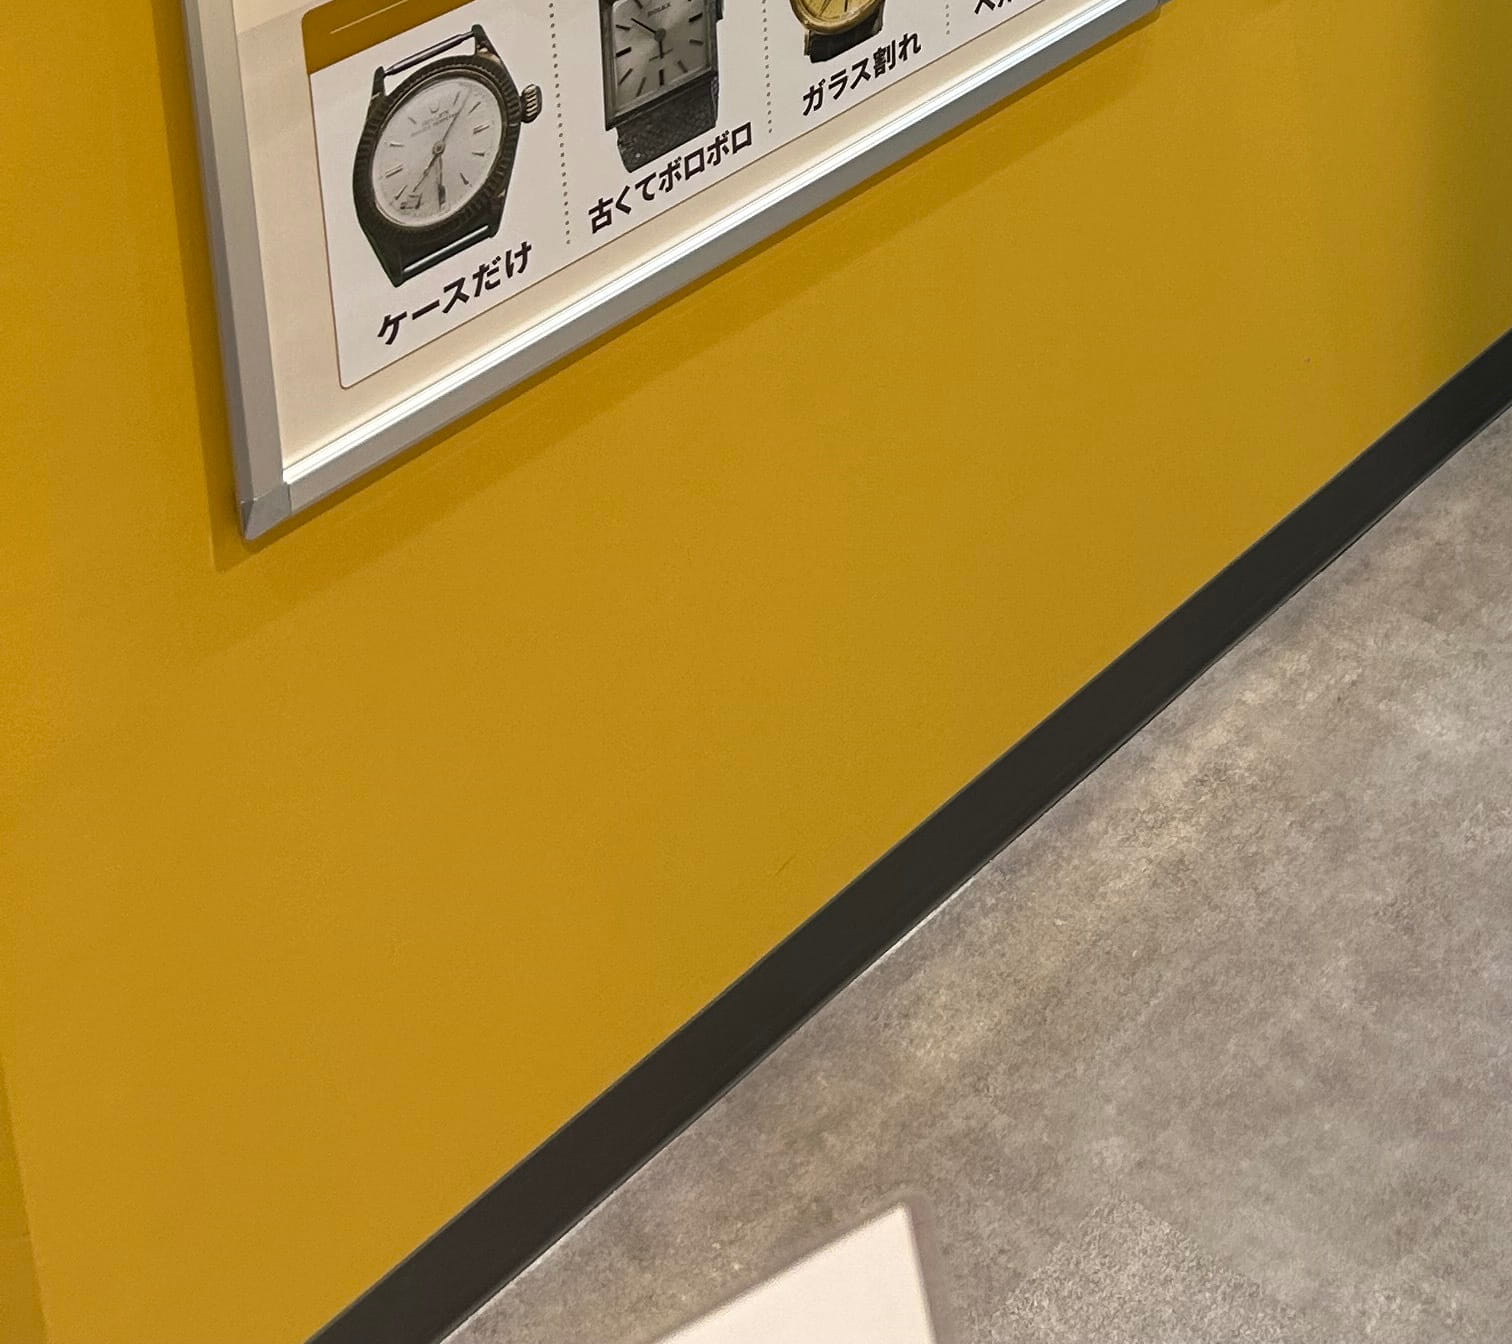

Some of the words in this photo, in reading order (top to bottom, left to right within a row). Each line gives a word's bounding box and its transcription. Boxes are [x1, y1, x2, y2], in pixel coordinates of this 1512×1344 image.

[801, 31, 924, 117] ガラス割れ
[587, 120, 753, 235] 古くてボロボロ
[377, 241, 533, 347] ケースだけ
